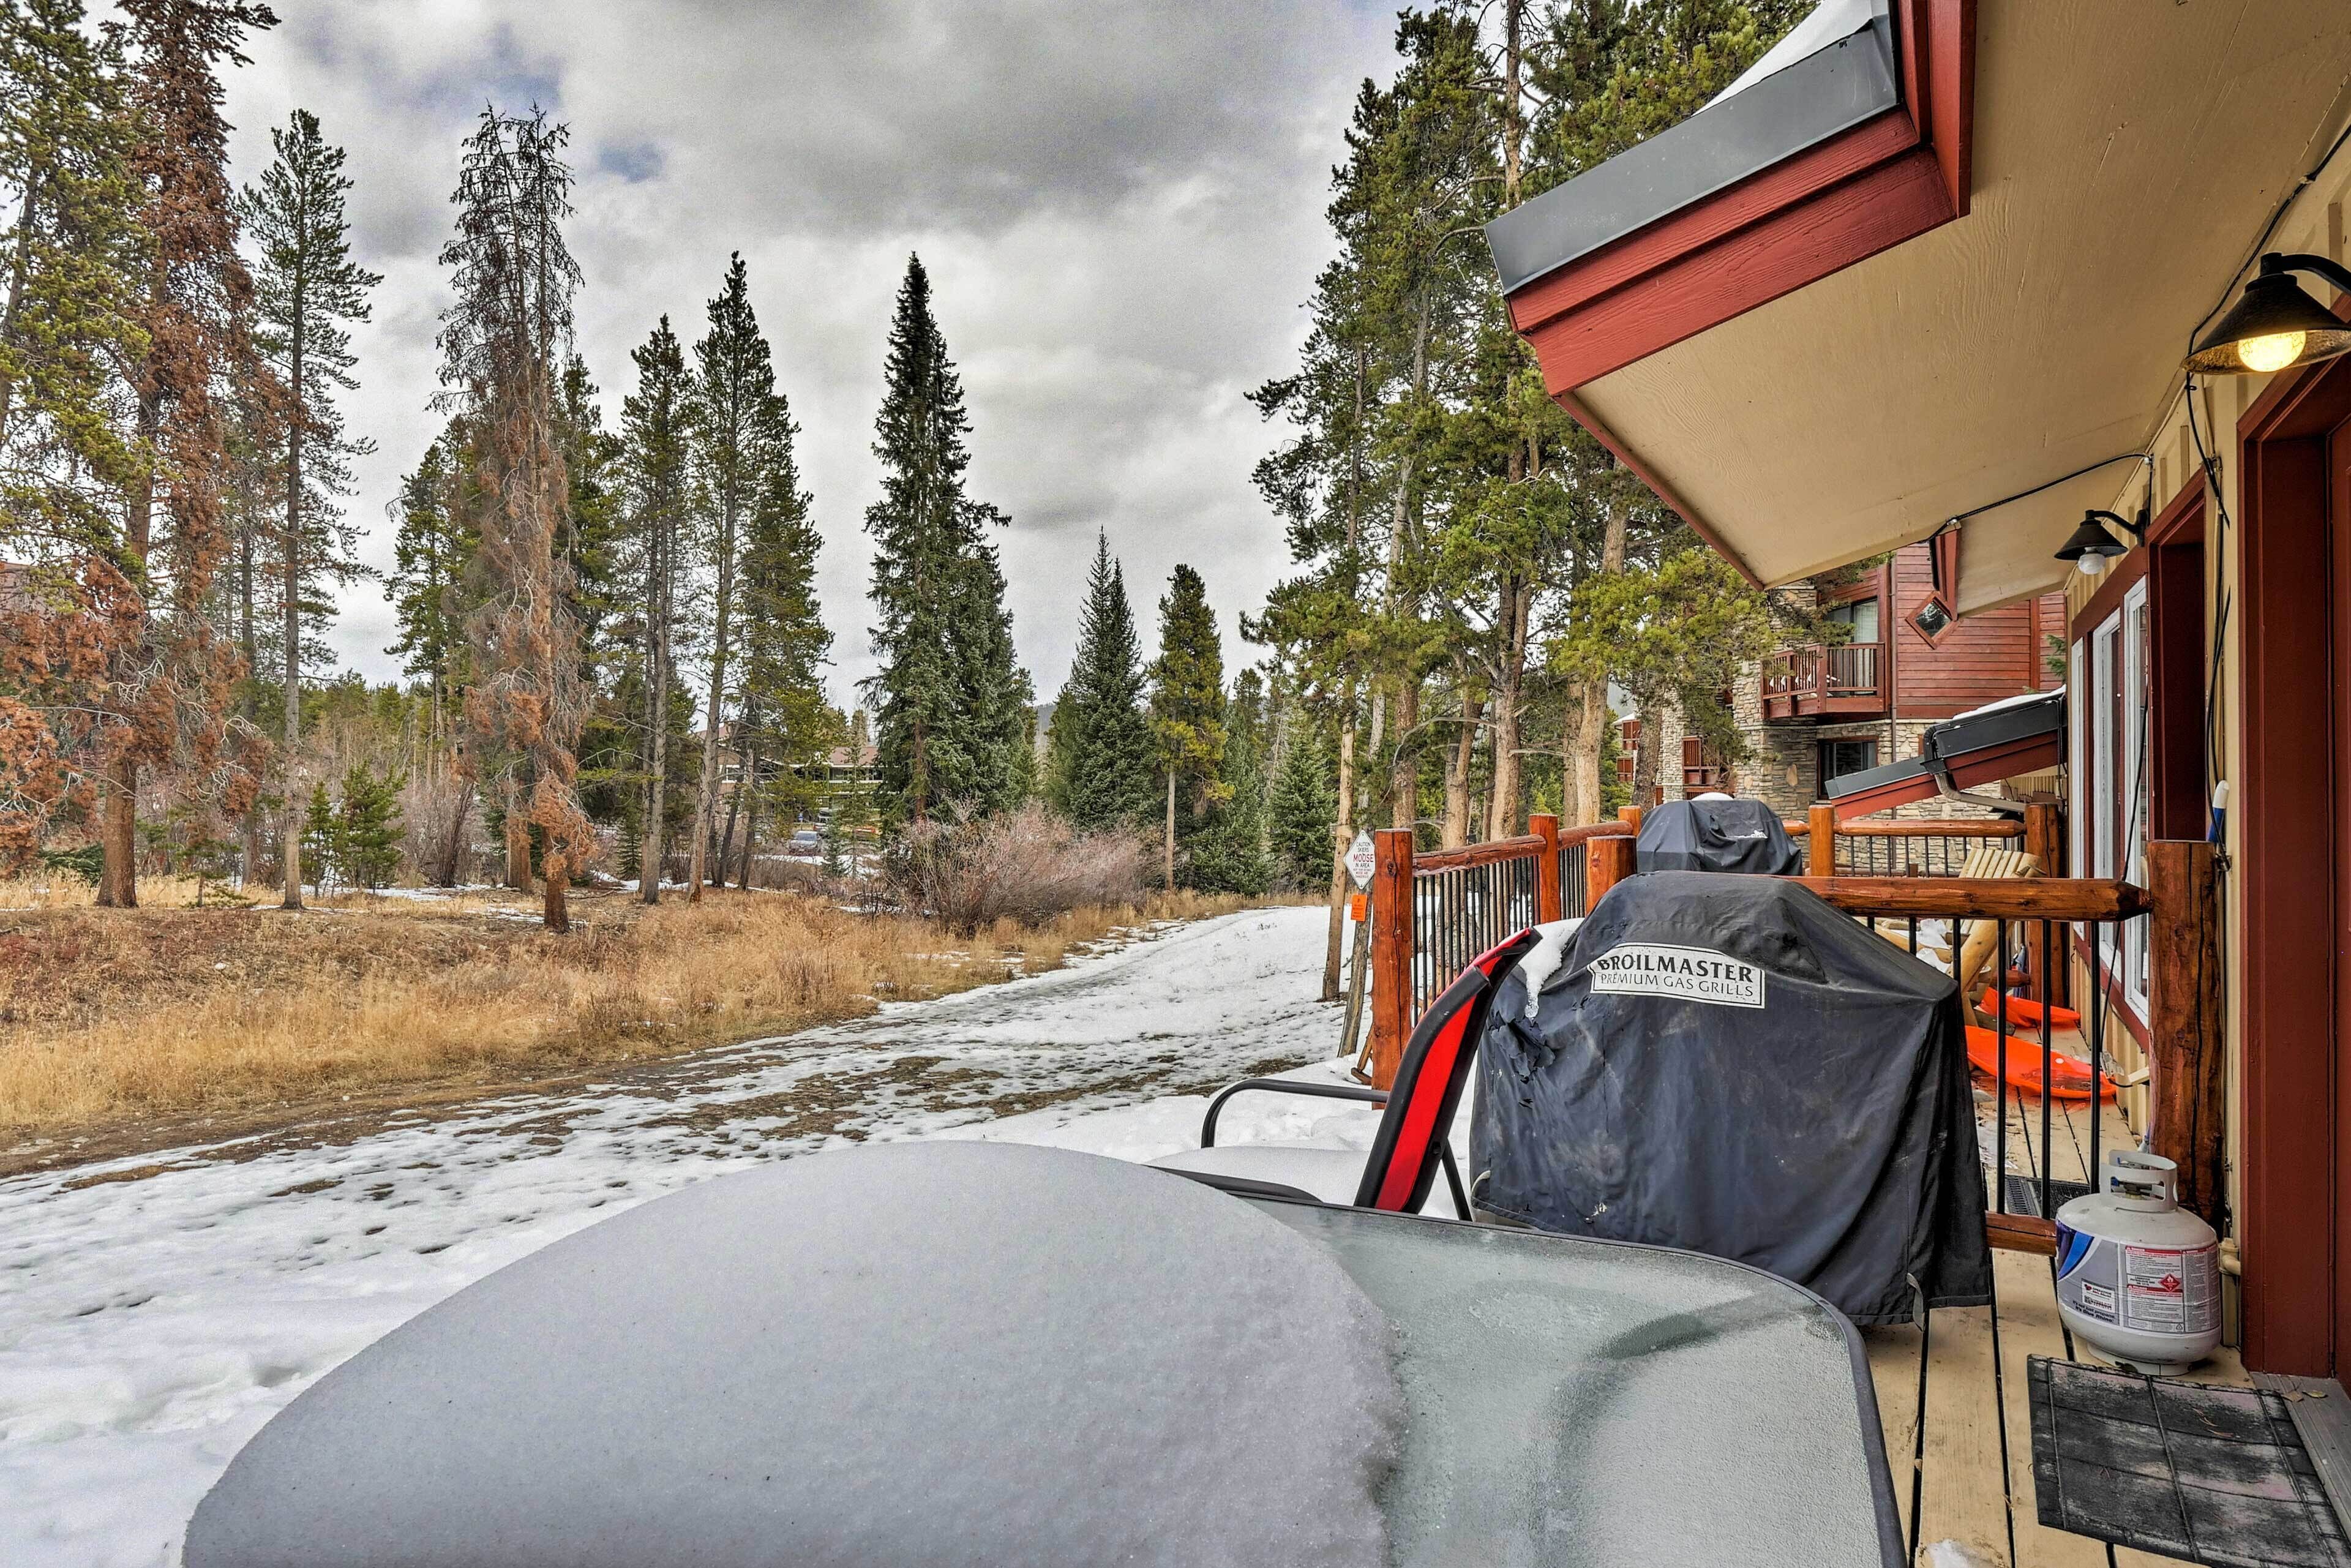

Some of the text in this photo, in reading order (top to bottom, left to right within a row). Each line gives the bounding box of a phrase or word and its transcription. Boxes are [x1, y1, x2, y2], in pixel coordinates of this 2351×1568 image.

[1353, 853, 1374, 862] MOOSE
[1597, 954, 1753, 983] BROILMASTER
[1600, 973, 1753, 997] PREMIUM GAS GRILLS
